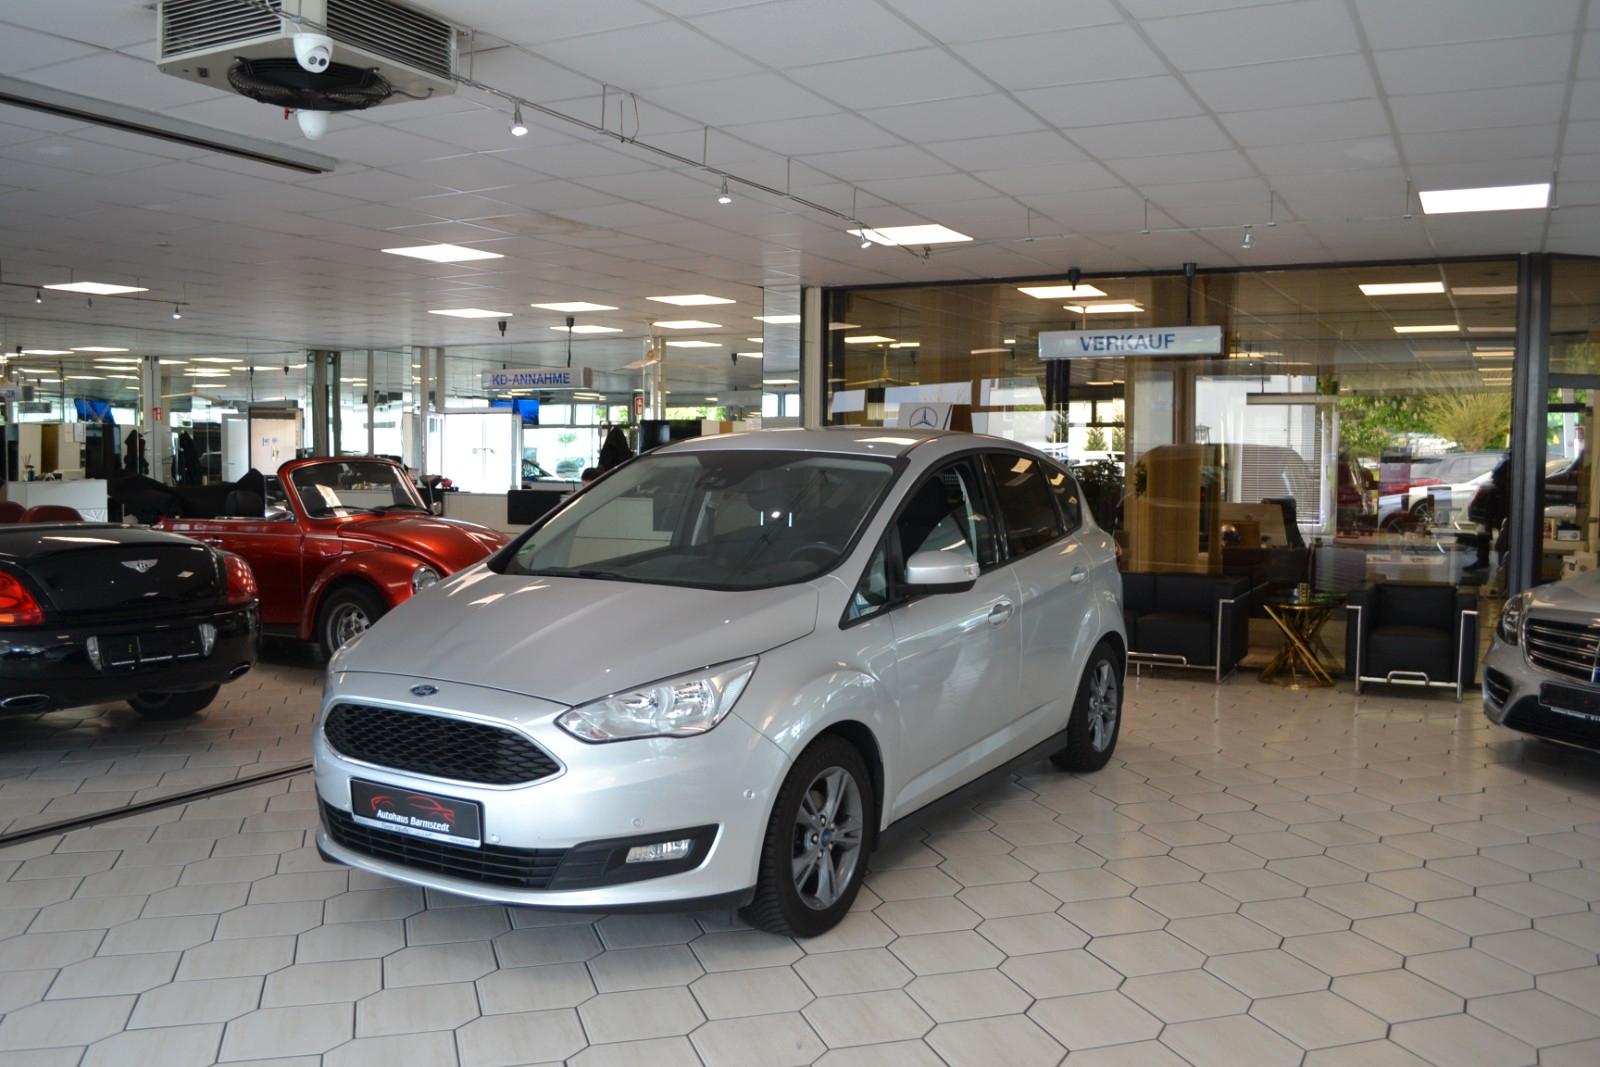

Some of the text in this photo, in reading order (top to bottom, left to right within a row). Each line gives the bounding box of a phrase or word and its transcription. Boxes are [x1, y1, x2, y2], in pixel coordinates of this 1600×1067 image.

[1079, 333, 1176, 352] VERKAUF
[492, 372, 571, 386] KD-ANNAHME
[376, 808, 409, 825] Autohaus
[410, 816, 450, 833] Barmstedt
